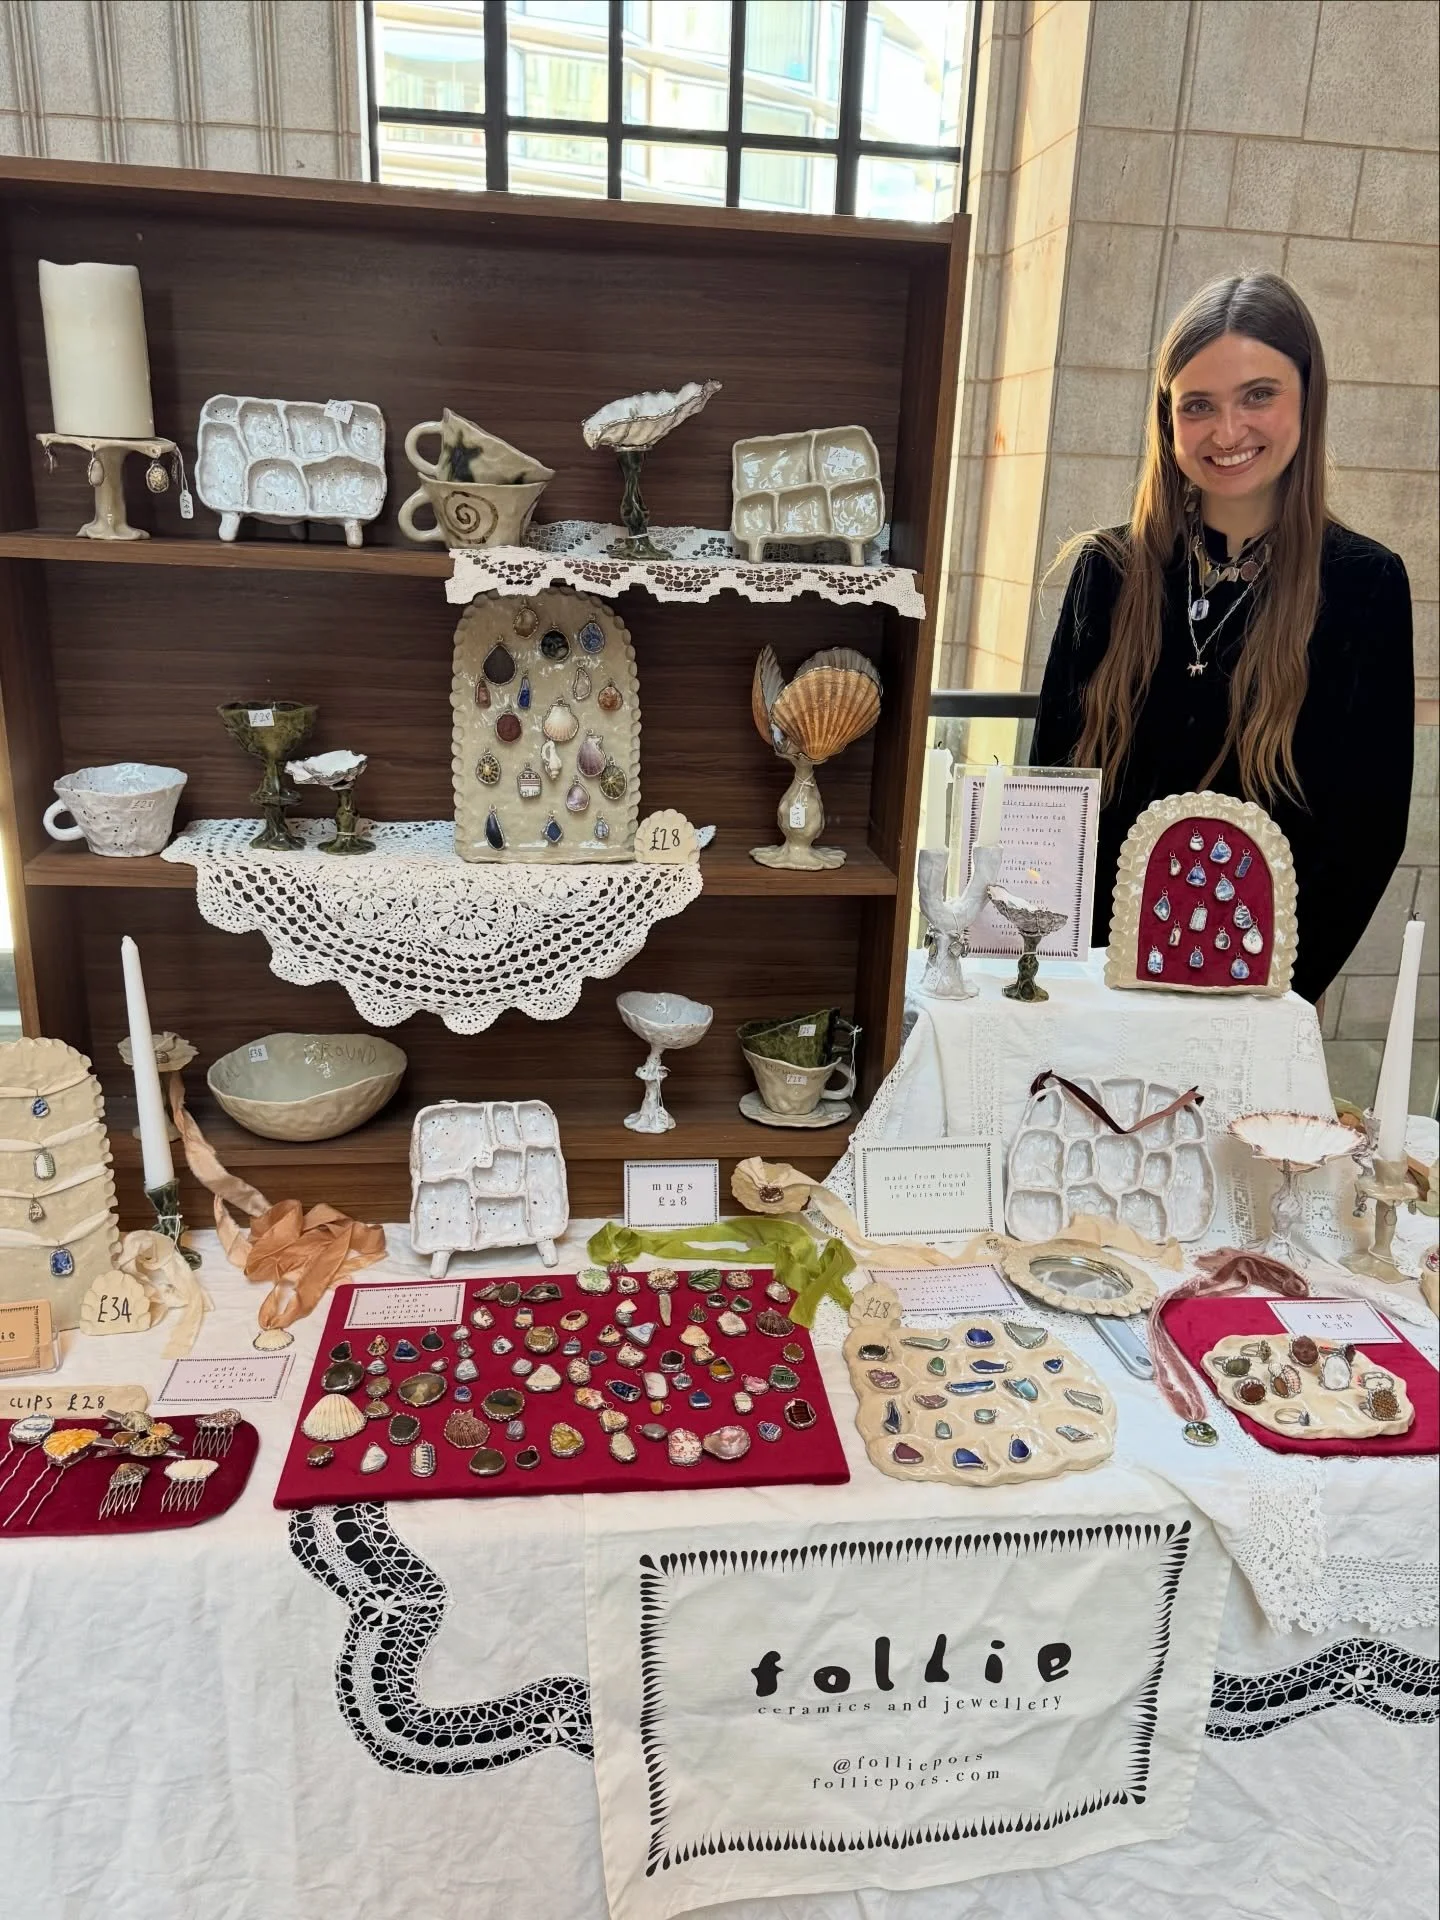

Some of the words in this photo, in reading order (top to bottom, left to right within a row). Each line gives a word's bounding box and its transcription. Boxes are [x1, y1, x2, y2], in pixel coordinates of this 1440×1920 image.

[884, 1173, 908, 1182] made
[914, 1173, 936, 1181] from
[889, 1183, 932, 1191] treasure
[938, 1180, 966, 1188] found
[652, 1183, 694, 1194] mugs
[906, 1190, 966, 1199] Portsmouth
[658, 1196, 688, 1207] £28
[97, 1295, 132, 1323] £34
[863, 1298, 891, 1319] £28
[1307, 1313, 1353, 1321] rings
[9, 1395, 53, 1412] CLIPS
[67, 1394, 106, 1412] £28
[750, 1633, 1073, 1697] follie
[757, 1700, 872, 1716] ceramics
[887, 1695, 928, 1713] and
[943, 1694, 1063, 1714] jewellery
[832, 1752, 984, 1775] @folliepots
[812, 1769, 1001, 1791] folliepots.com
